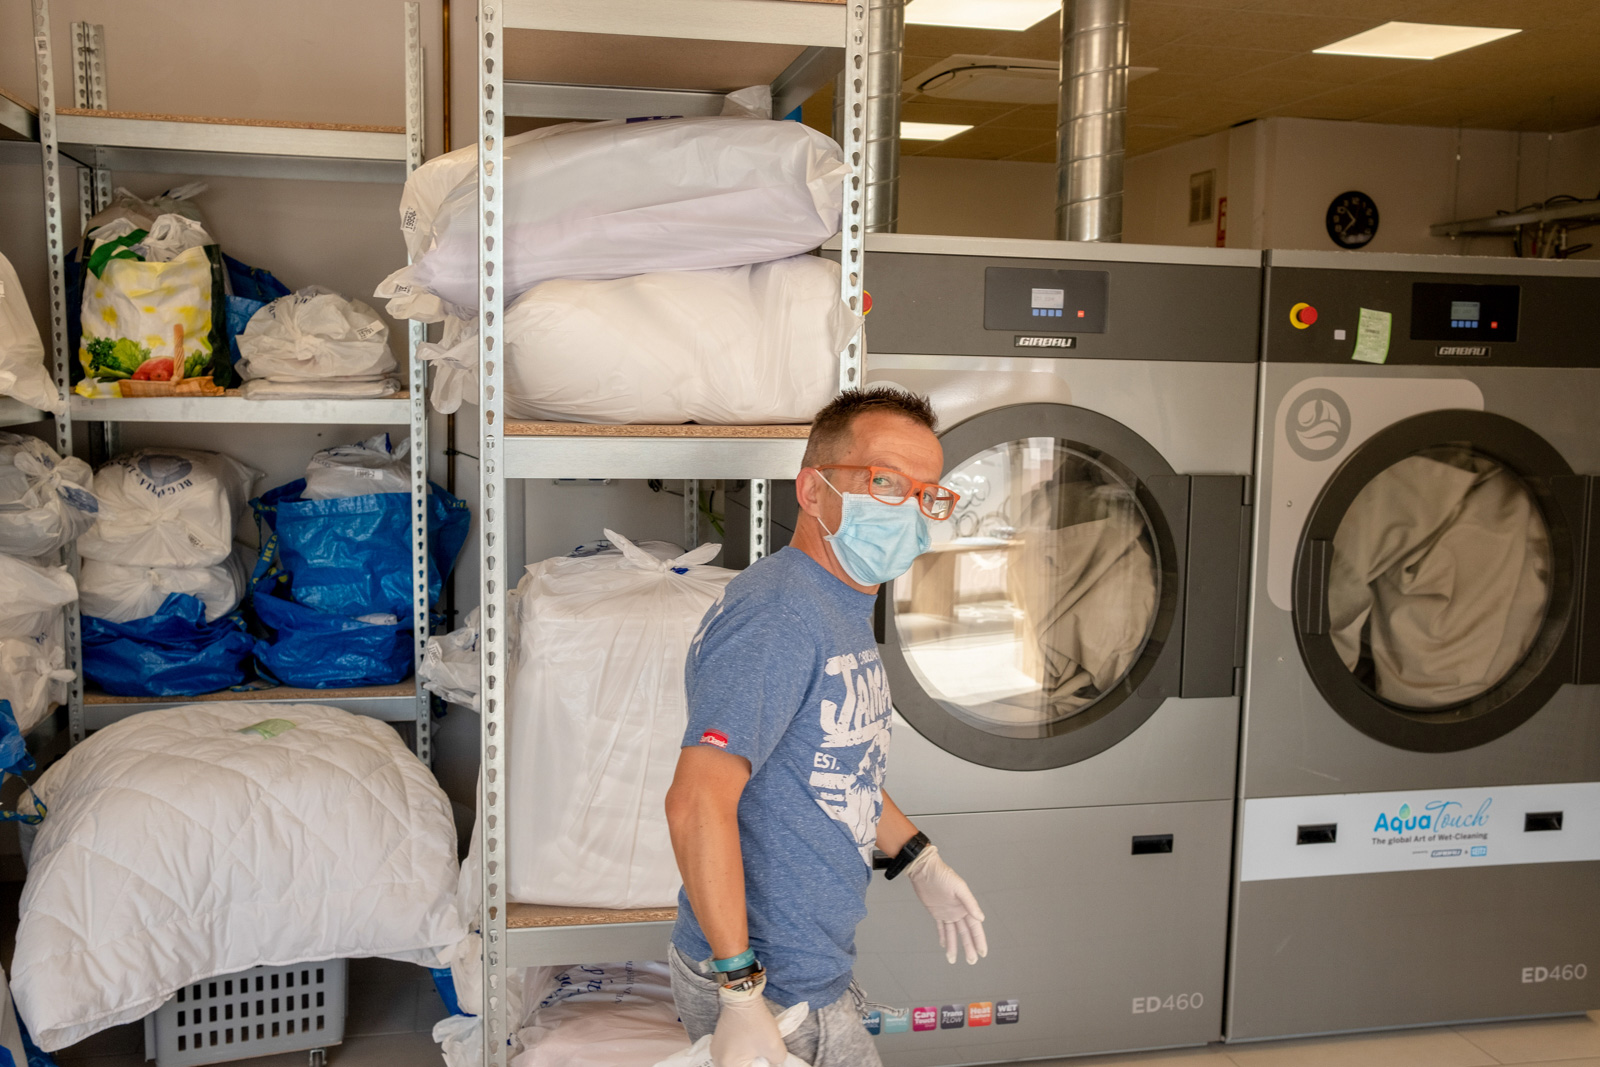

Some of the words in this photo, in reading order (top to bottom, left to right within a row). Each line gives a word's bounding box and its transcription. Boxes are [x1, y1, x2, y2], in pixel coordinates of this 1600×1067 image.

[1018, 336, 1072, 348] GIRBAU
[1438, 346, 1487, 356] GIRBAU
[262, 534, 278, 562] IKEA
[813, 751, 840, 771] EST.
[1372, 837, 1386, 845] The
[1388, 836, 1412, 846] global
[1413, 835, 1426, 843] Art
[1428, 834, 1437, 842] of
[1521, 963, 1588, 984] ED460
[997, 1004, 1018, 1012] WET
[1131, 992, 1204, 1014] ED460
[942, 1010, 963, 1018] Trans
[970, 1006, 991, 1014] Heat
[914, 1017, 936, 1025] Touch
